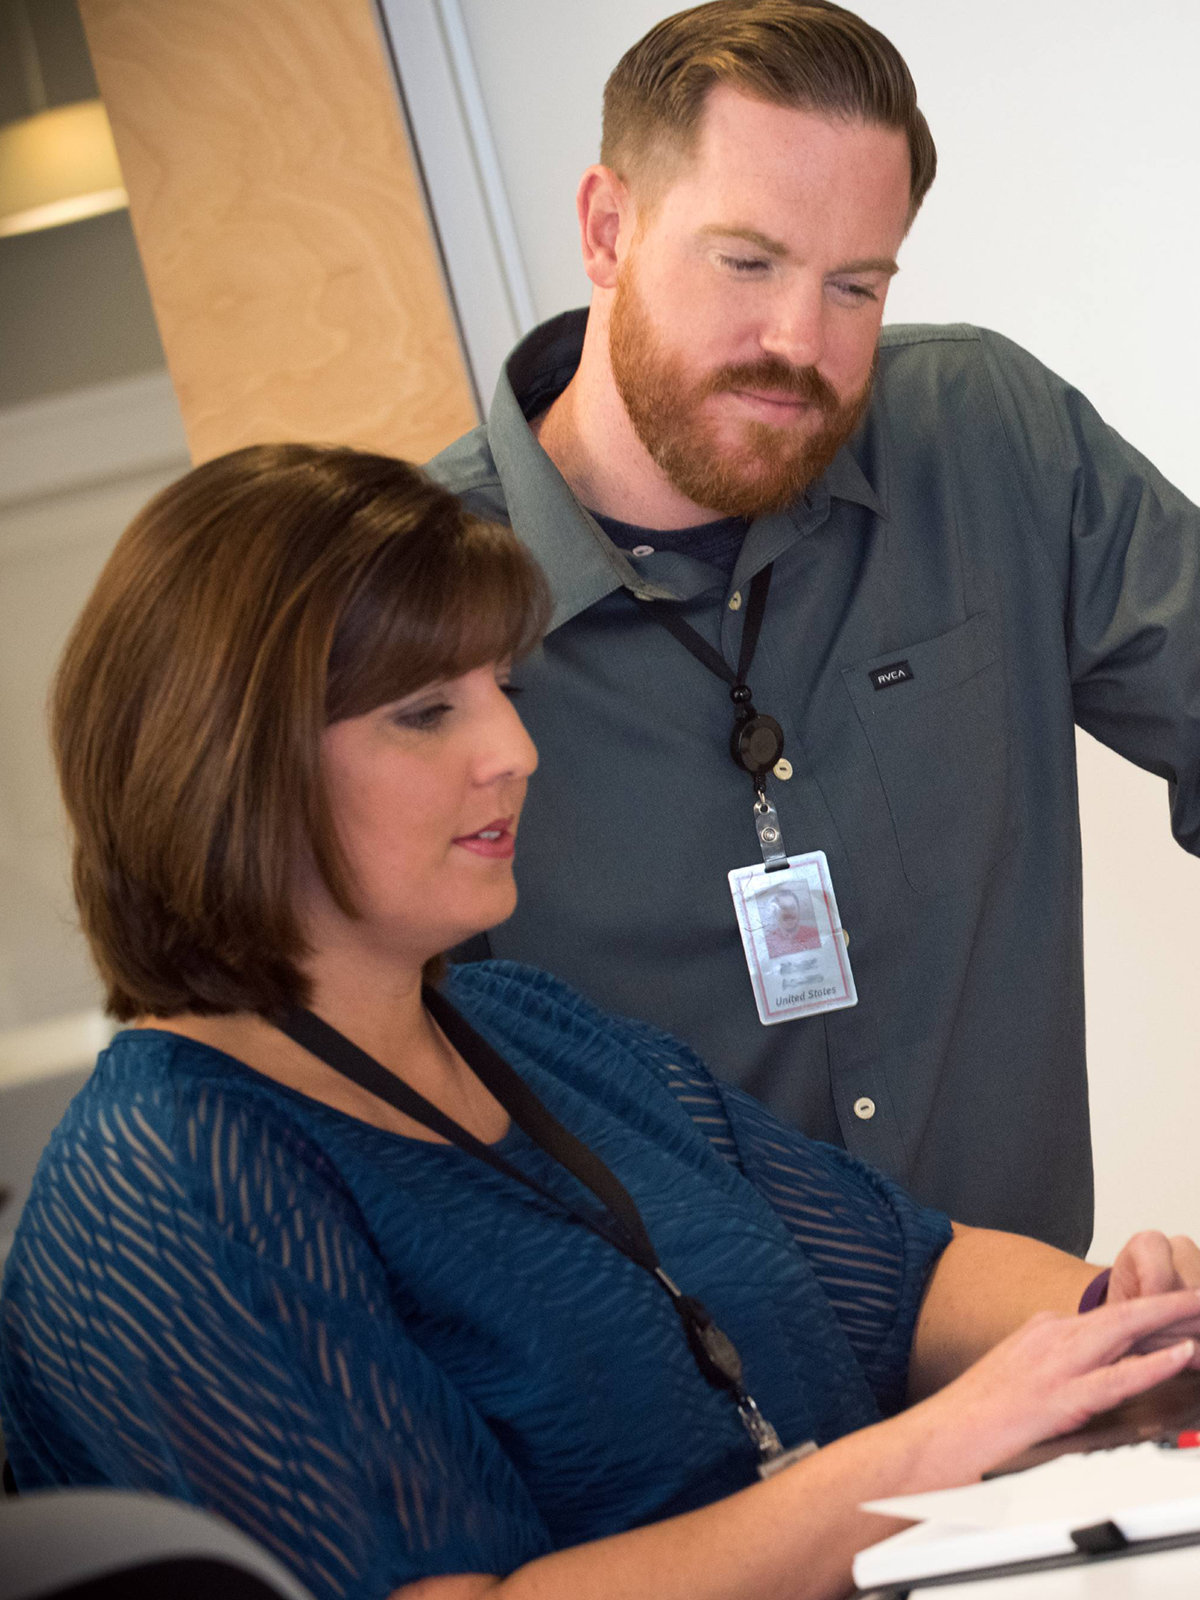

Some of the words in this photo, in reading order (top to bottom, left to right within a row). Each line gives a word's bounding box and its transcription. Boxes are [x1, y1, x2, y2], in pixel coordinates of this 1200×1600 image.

[877, 669, 906, 684] RVCA
[775, 990, 806, 1006] United
[808, 986, 837, 999] States
